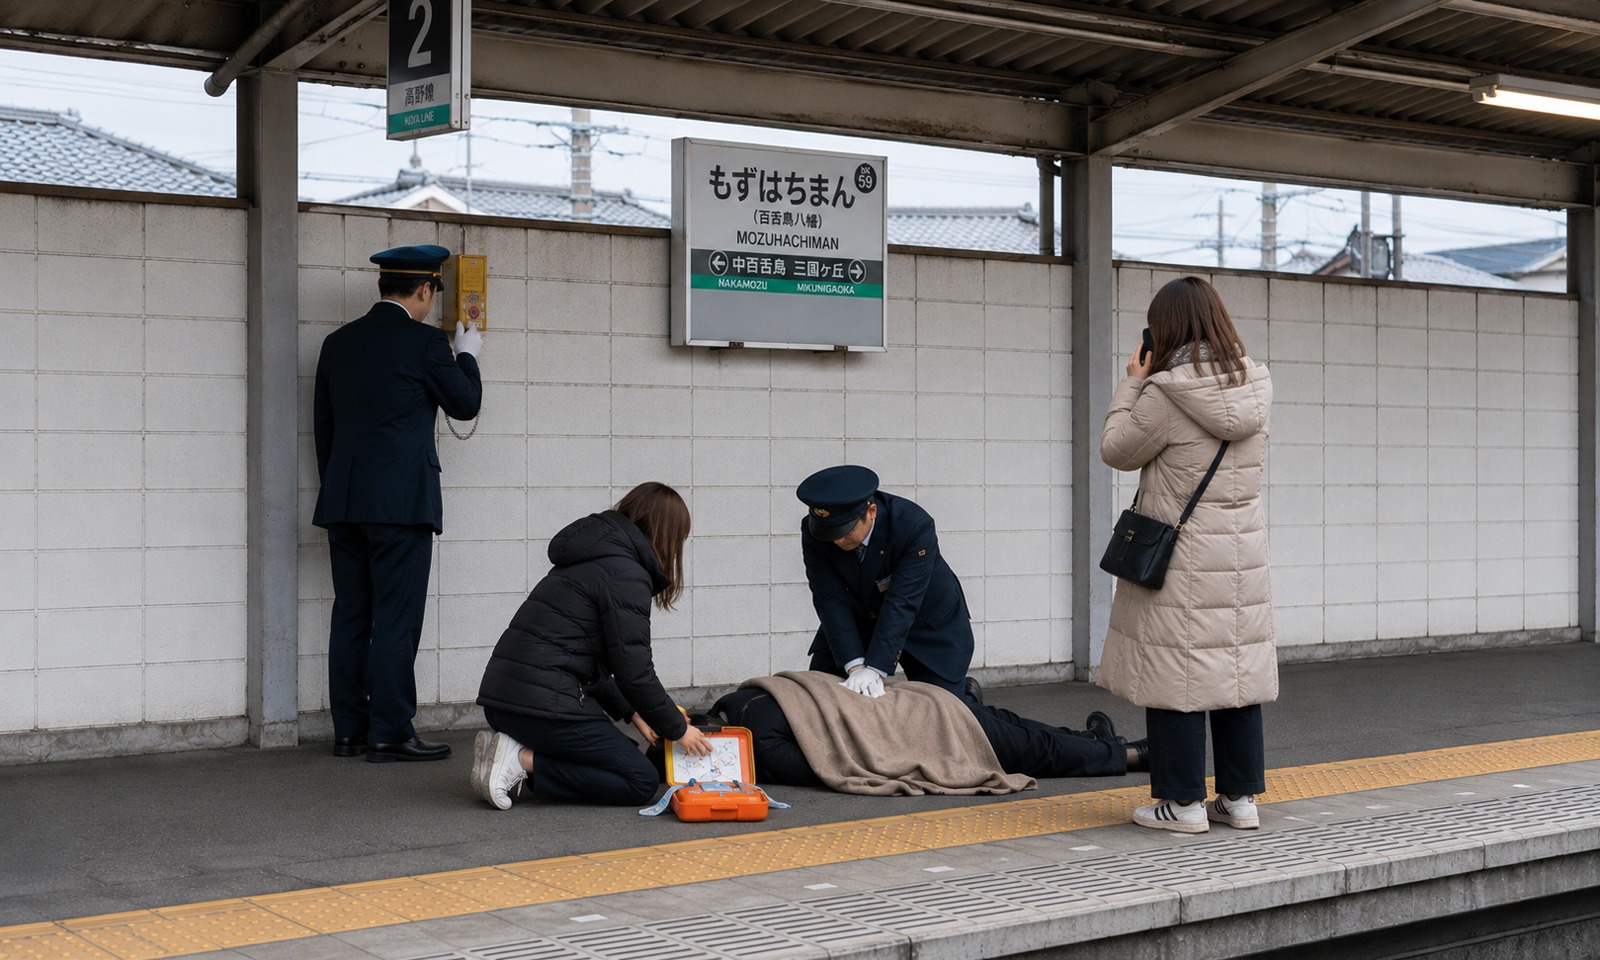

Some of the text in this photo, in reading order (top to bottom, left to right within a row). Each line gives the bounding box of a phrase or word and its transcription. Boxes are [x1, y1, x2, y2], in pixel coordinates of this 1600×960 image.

[408, 0, 432, 68] 2
[709, 165, 855, 209] もずはちまん
[858, 174, 872, 189] 59
[737, 231, 839, 250] MOZUHACHIMAN
[718, 278, 855, 295] NAKAMOZU MIKUNIGAOKA
